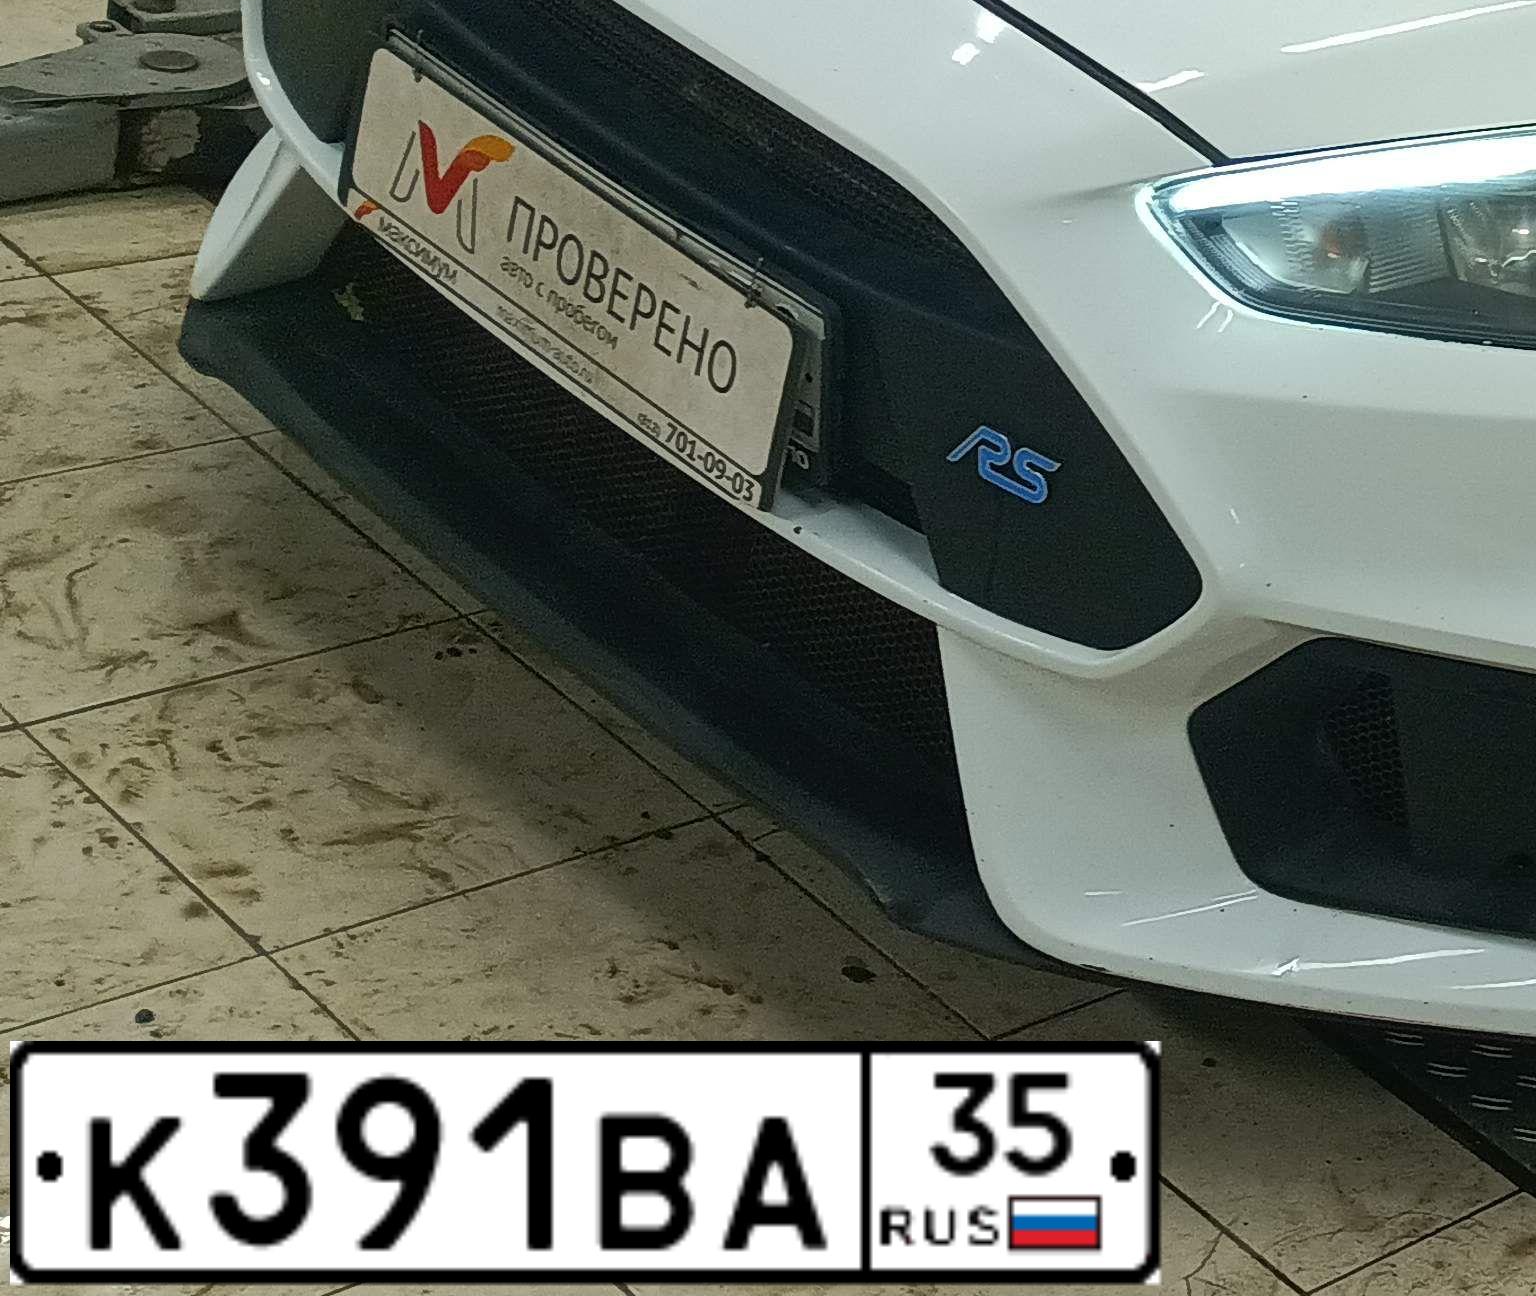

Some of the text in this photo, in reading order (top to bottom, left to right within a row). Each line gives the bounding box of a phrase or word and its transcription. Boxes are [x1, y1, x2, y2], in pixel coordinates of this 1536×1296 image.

[506, 195, 738, 395] ПРОВЕРЕНО
[664, 421, 755, 502] 701-09-03
[945, 424, 1063, 505] RS
